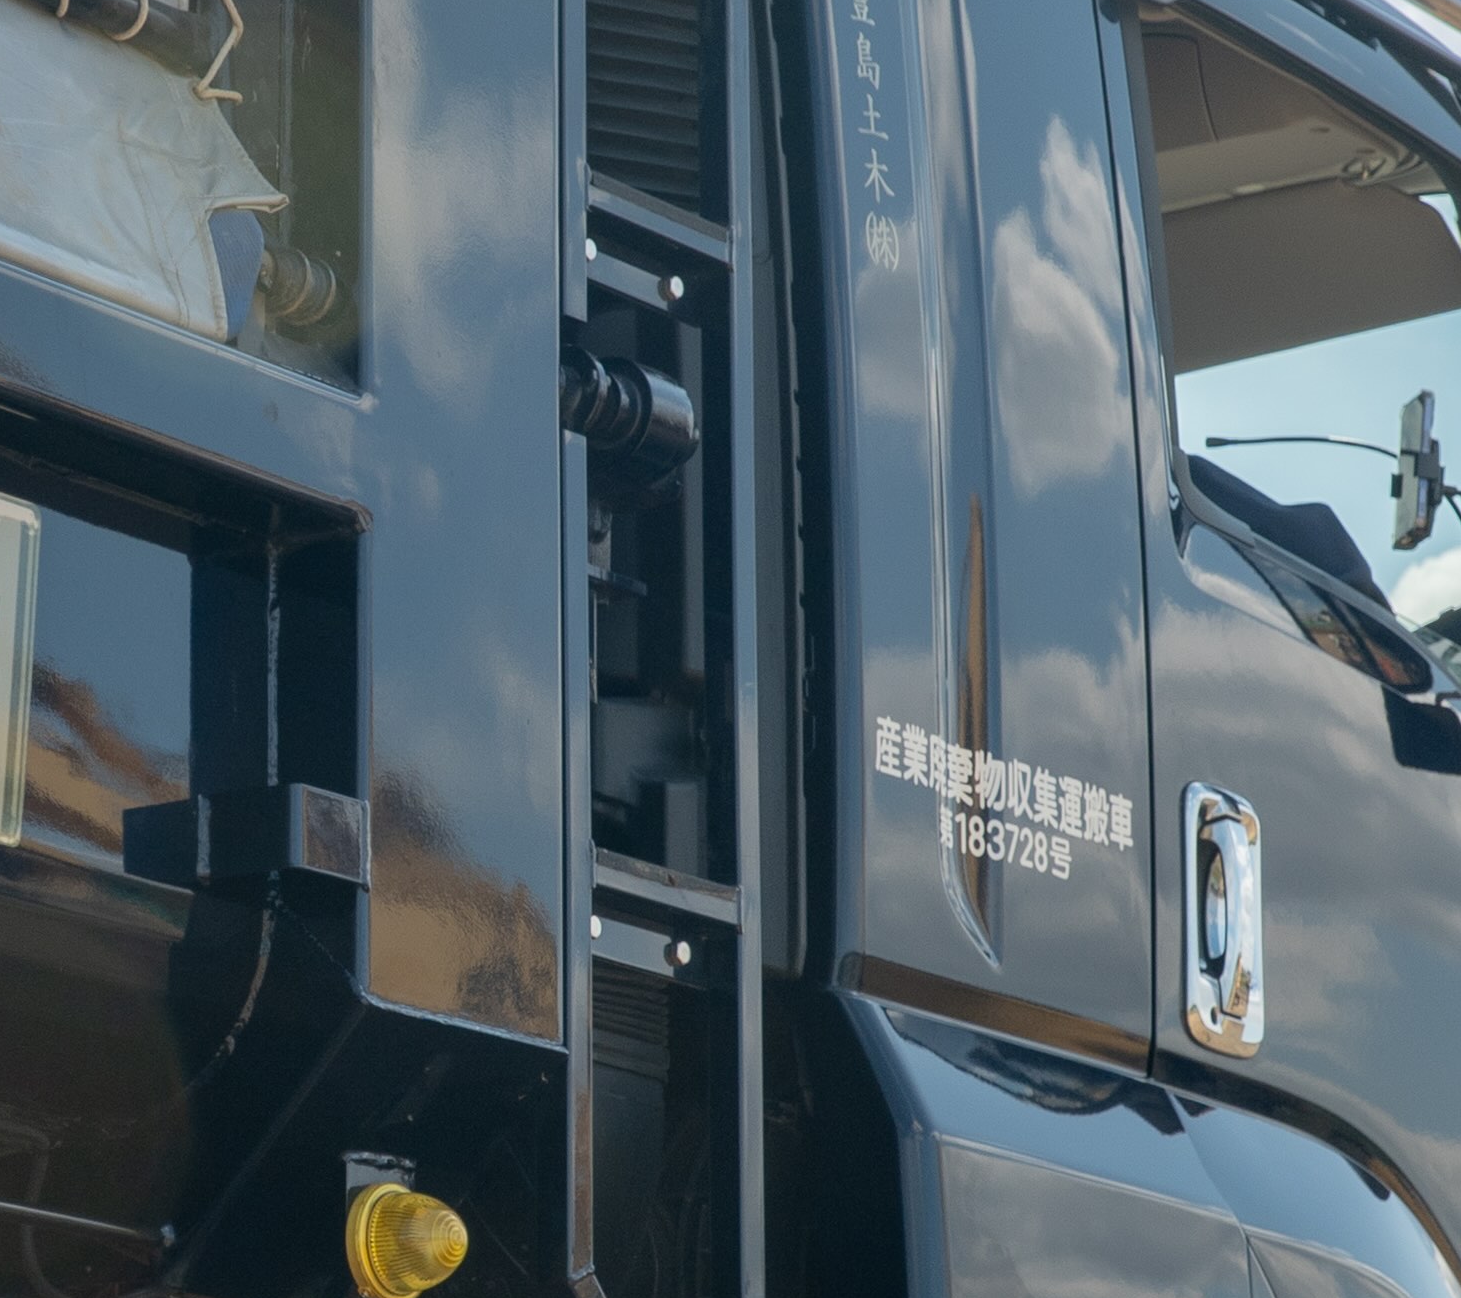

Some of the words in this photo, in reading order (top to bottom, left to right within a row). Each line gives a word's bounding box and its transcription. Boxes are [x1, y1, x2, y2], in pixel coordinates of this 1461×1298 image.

[875, 715, 1134, 851] 産業廃棄物収集運搬車
[939, 803, 1072, 880] 第183728号
